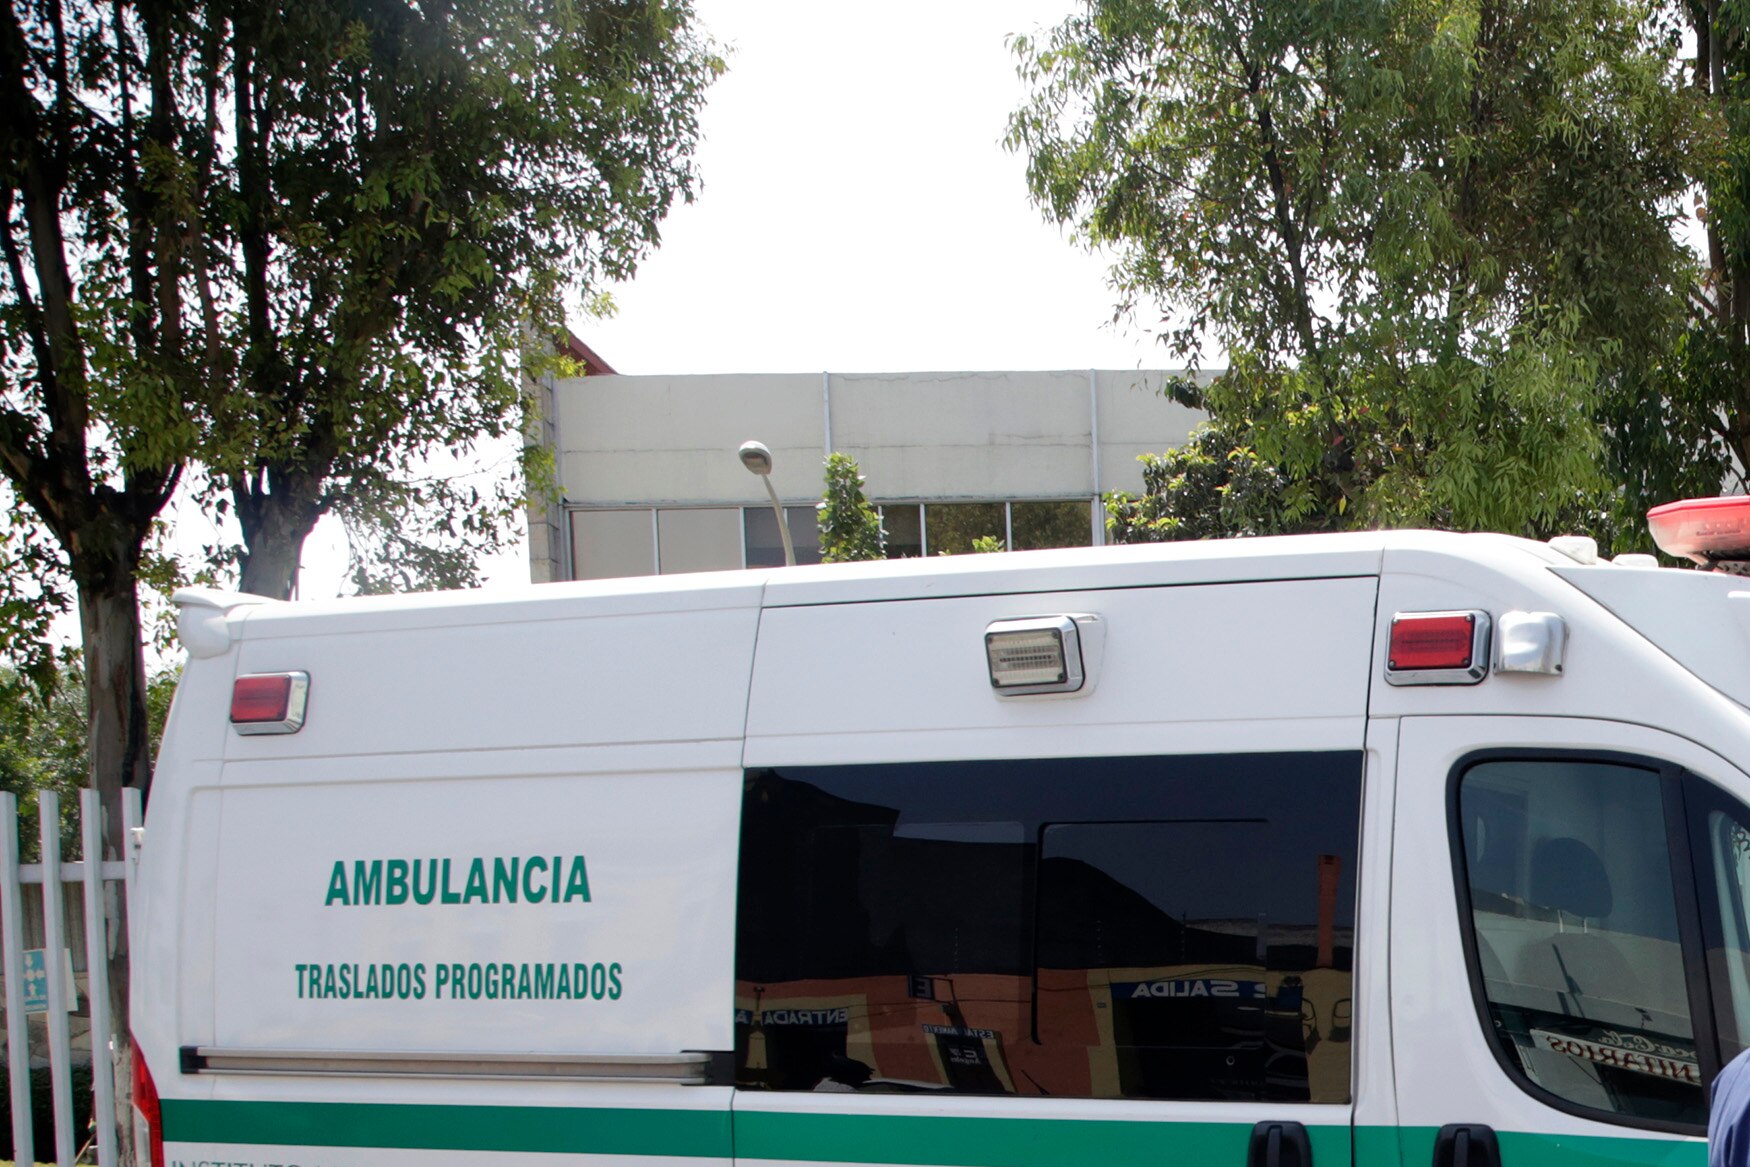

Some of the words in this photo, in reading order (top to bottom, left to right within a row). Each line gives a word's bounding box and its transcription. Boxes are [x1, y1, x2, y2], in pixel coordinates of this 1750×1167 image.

[325, 855, 592, 906] AMBULANCIA
[295, 962, 426, 1000] TRASLADOS
[435, 962, 622, 1001] PROGRAMADOS
